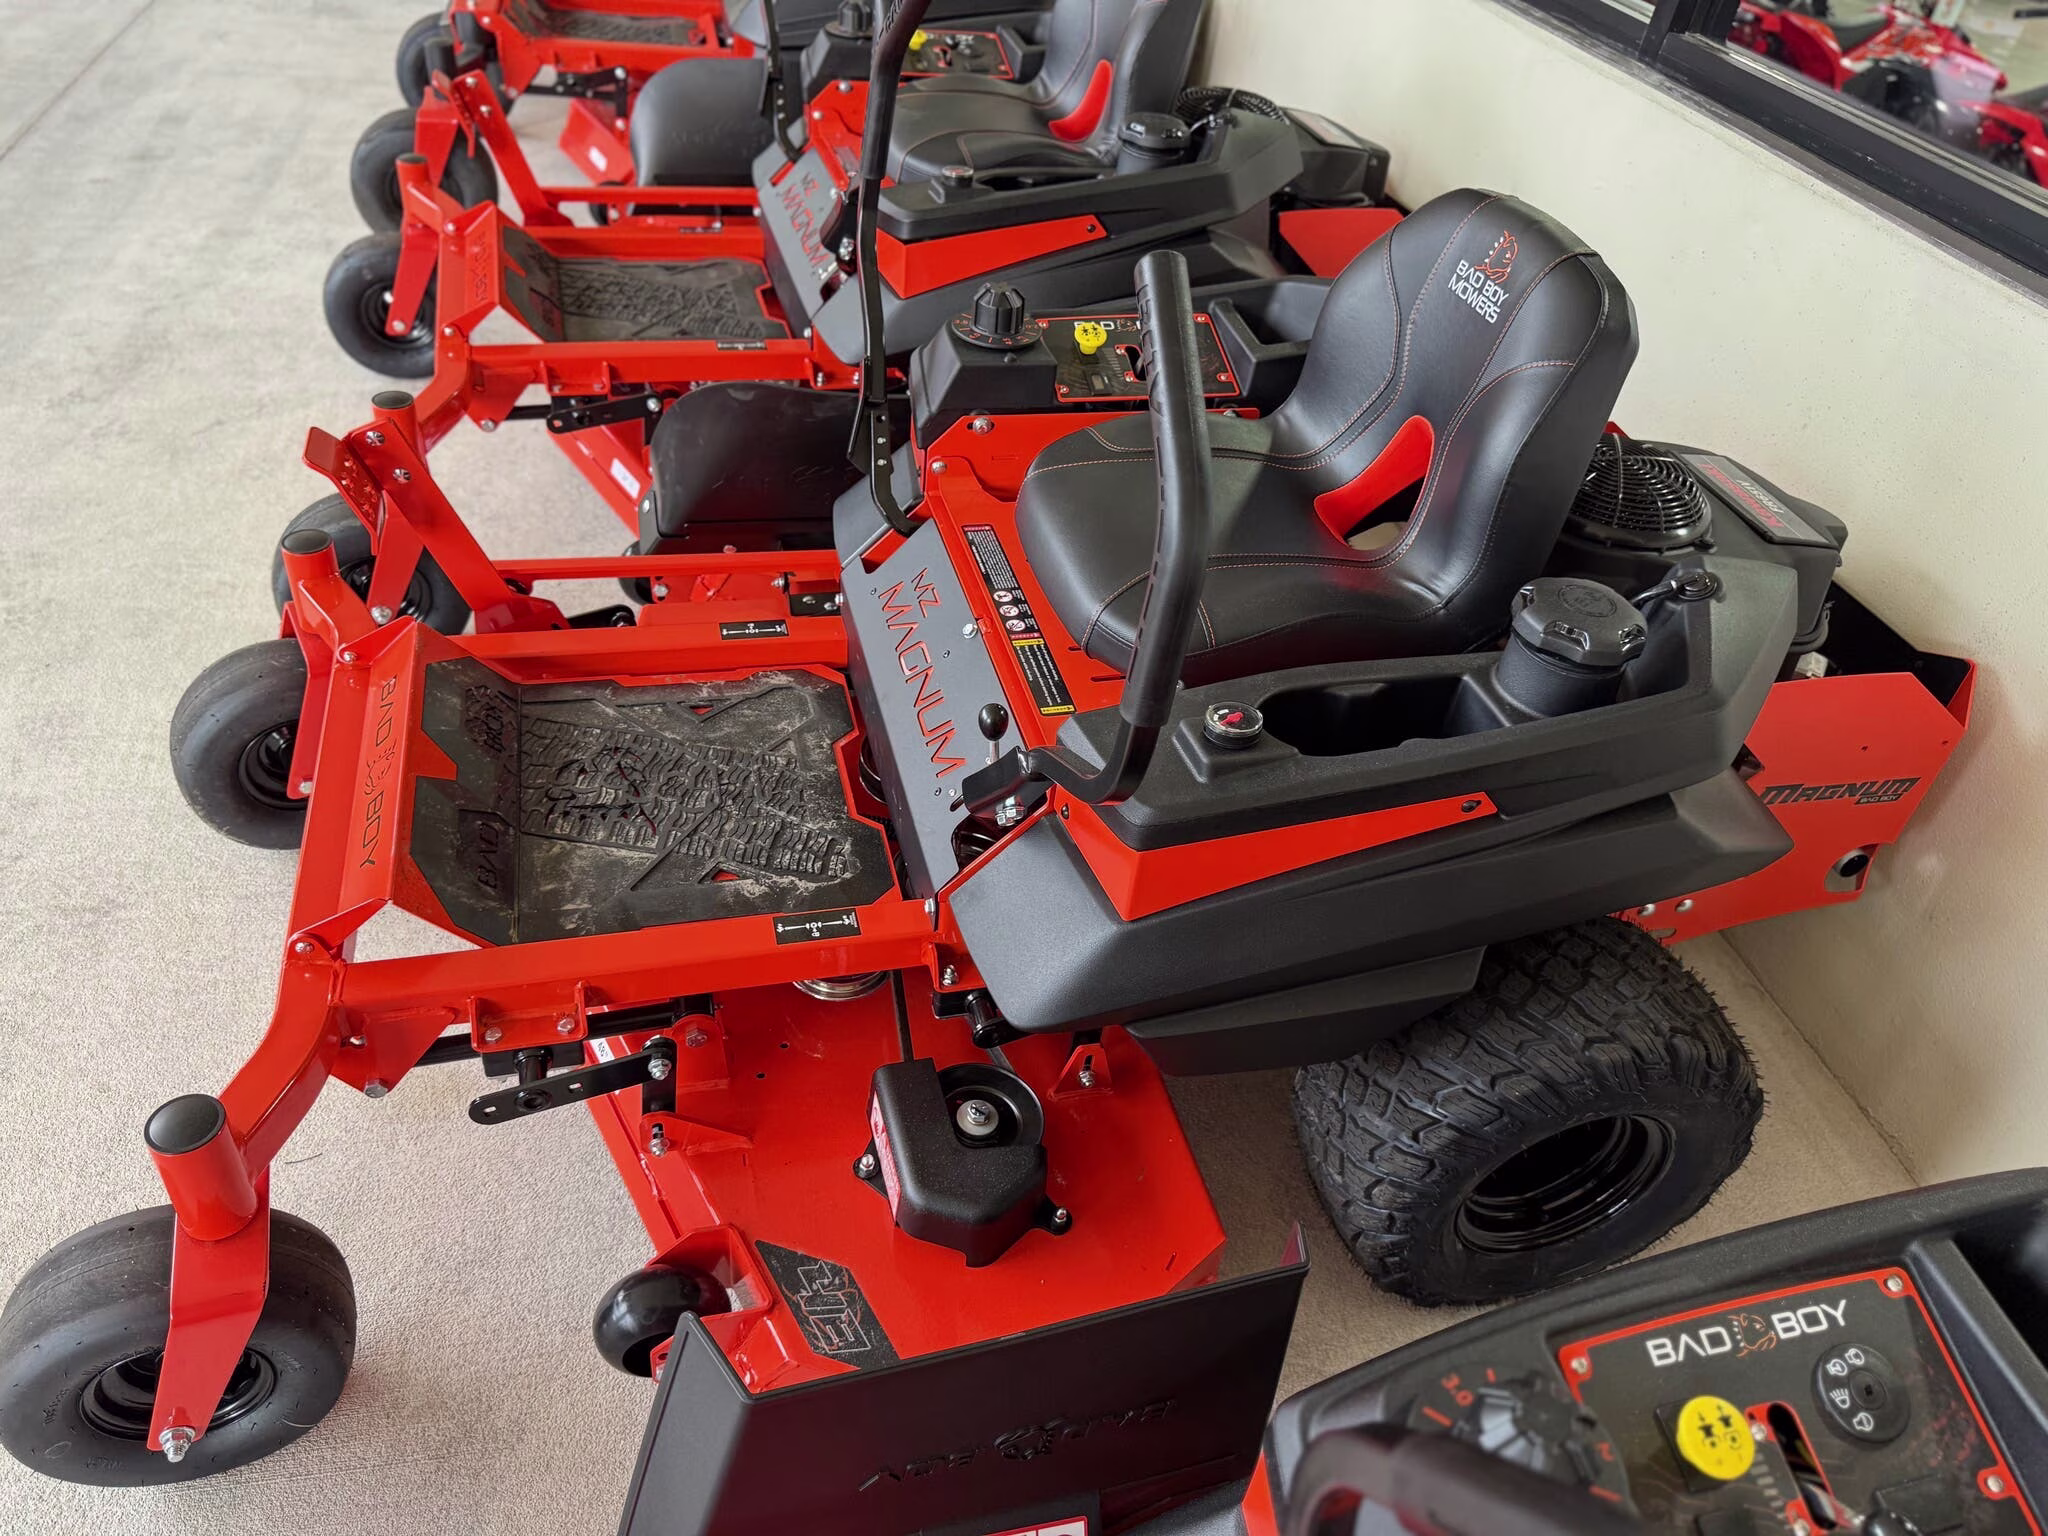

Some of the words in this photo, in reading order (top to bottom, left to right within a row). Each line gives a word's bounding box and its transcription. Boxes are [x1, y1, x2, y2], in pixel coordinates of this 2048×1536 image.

[1448, 273, 1501, 323] MOWERS
[1456, 259, 1485, 288] BAD
[1482, 279, 1509, 306] BOY
[911, 567, 941, 619] MZ
[878, 581, 966, 779] MAGNUM
[376, 674, 398, 748] BAD
[1760, 777, 1922, 805] MAGNUM
[360, 791, 384, 869] BOY
[1646, 1326, 1733, 1367] BAD
[1771, 1299, 1847, 1340] BOY
